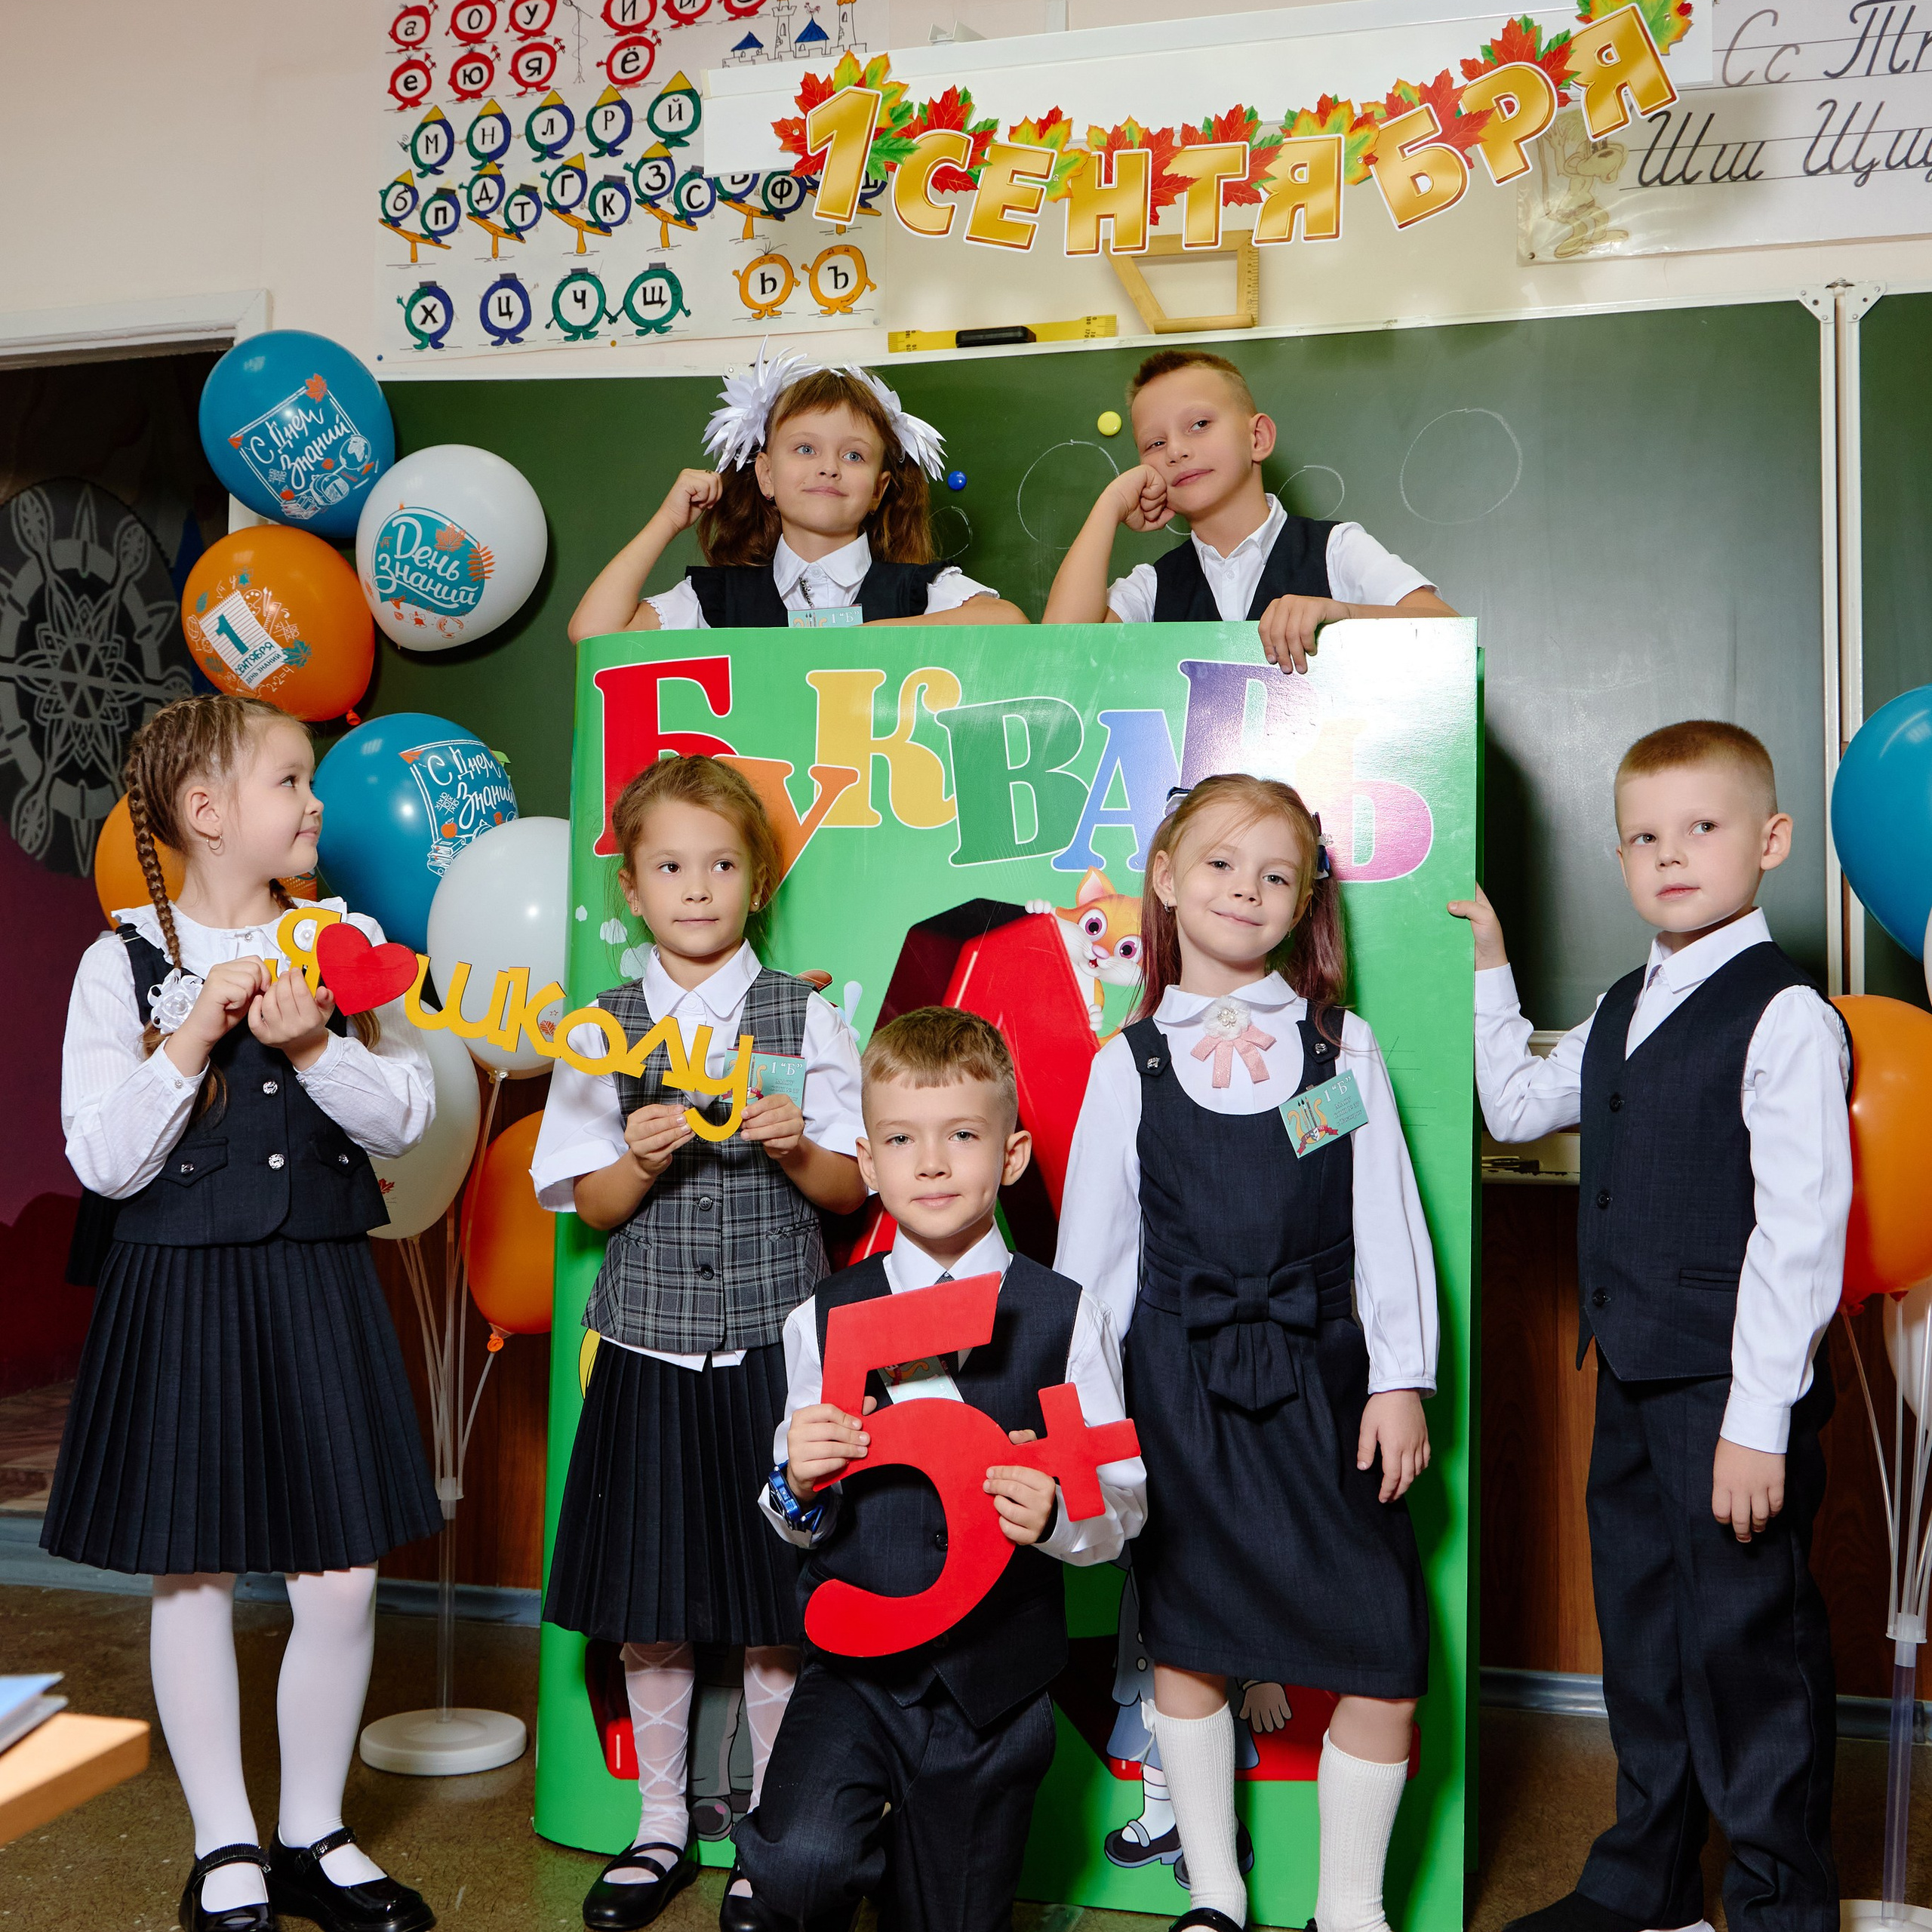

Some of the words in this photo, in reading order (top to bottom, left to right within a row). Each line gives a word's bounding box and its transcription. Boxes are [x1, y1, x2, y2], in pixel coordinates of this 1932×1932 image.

[806, 85, 881, 225] 1
[892, 2, 1680, 257] СЕНТЯБРЯ
[392, 516, 460, 581] День
[216, 614, 250, 656] 1
[235, 641, 275, 677] СЕНТЯБРЯ
[245, 672, 260, 685] ДЕНЬ
[257, 653, 282, 675] ЗНАНИЙ
[427, 755, 453, 786] С
[263, 906, 343, 1000] Я
